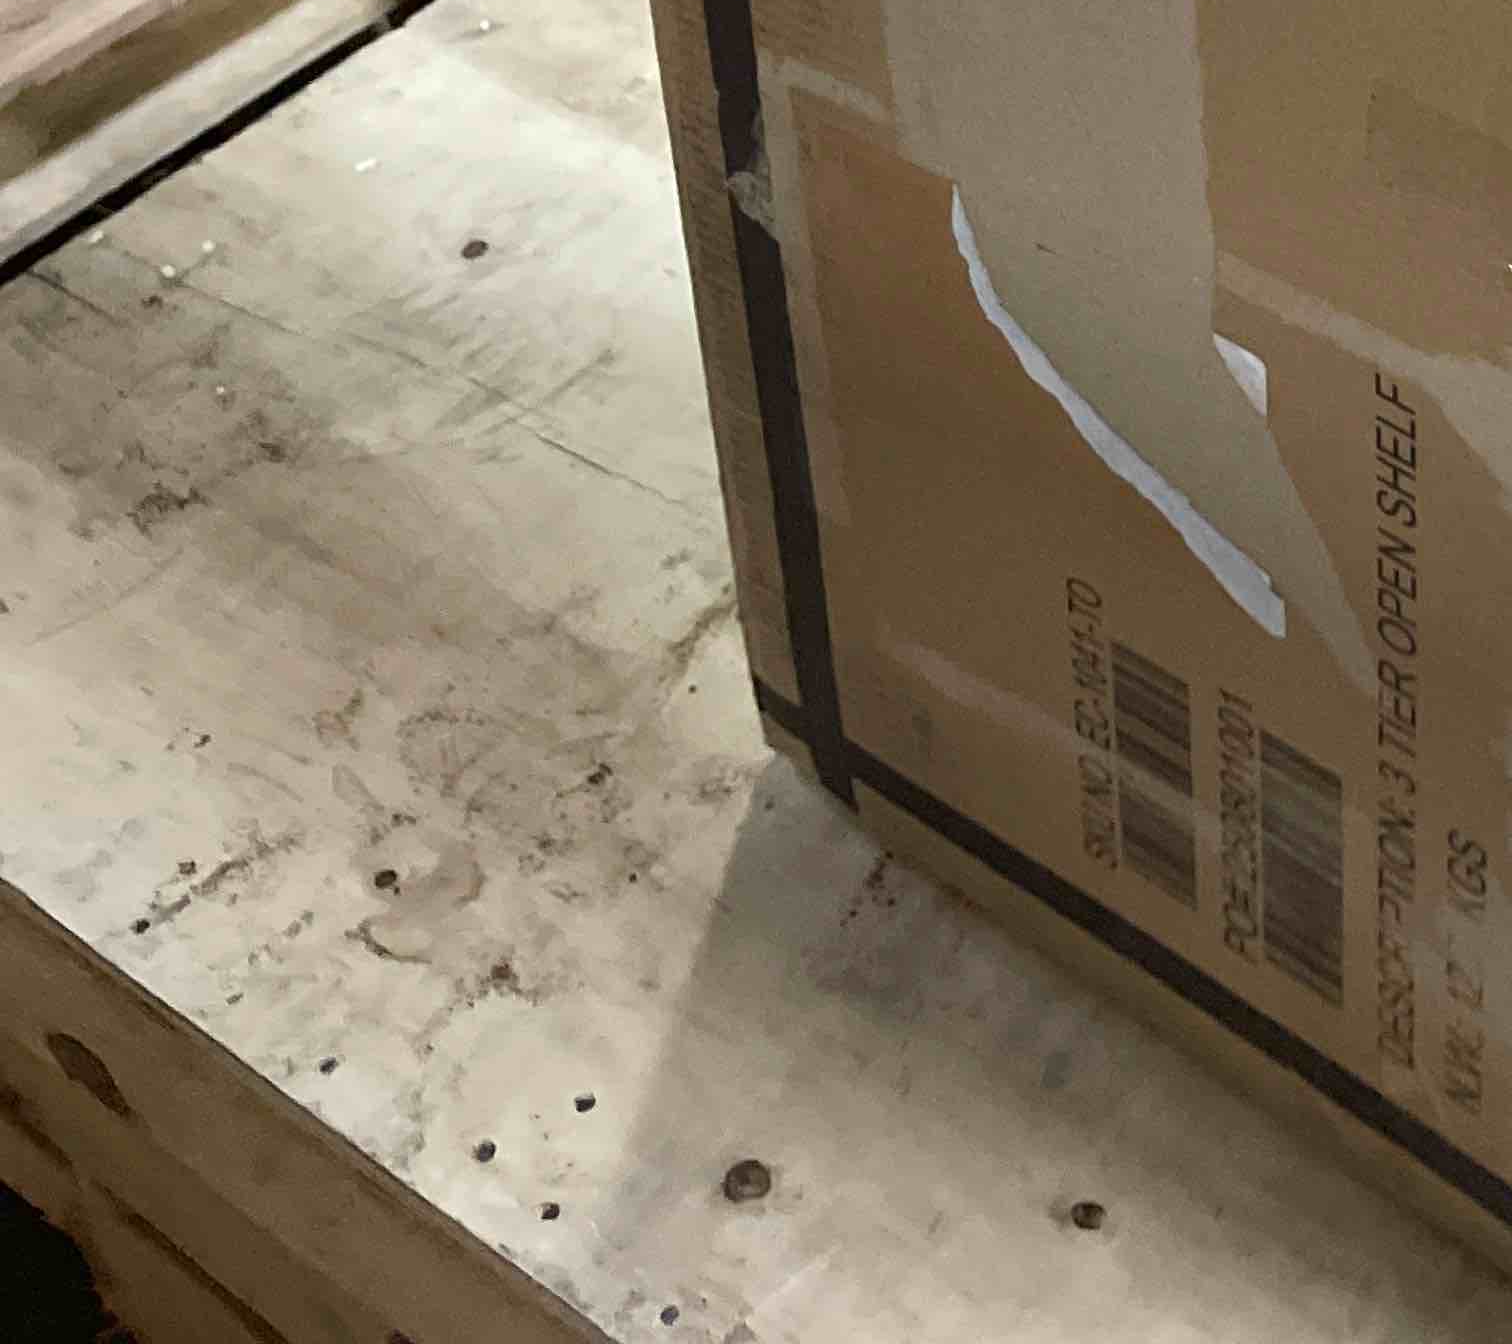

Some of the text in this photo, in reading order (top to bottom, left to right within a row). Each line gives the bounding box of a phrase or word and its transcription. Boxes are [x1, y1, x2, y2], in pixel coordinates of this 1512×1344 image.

[1374, 370, 1418, 1070] DESCRPTION: 3 TIER OPEN SHELF
